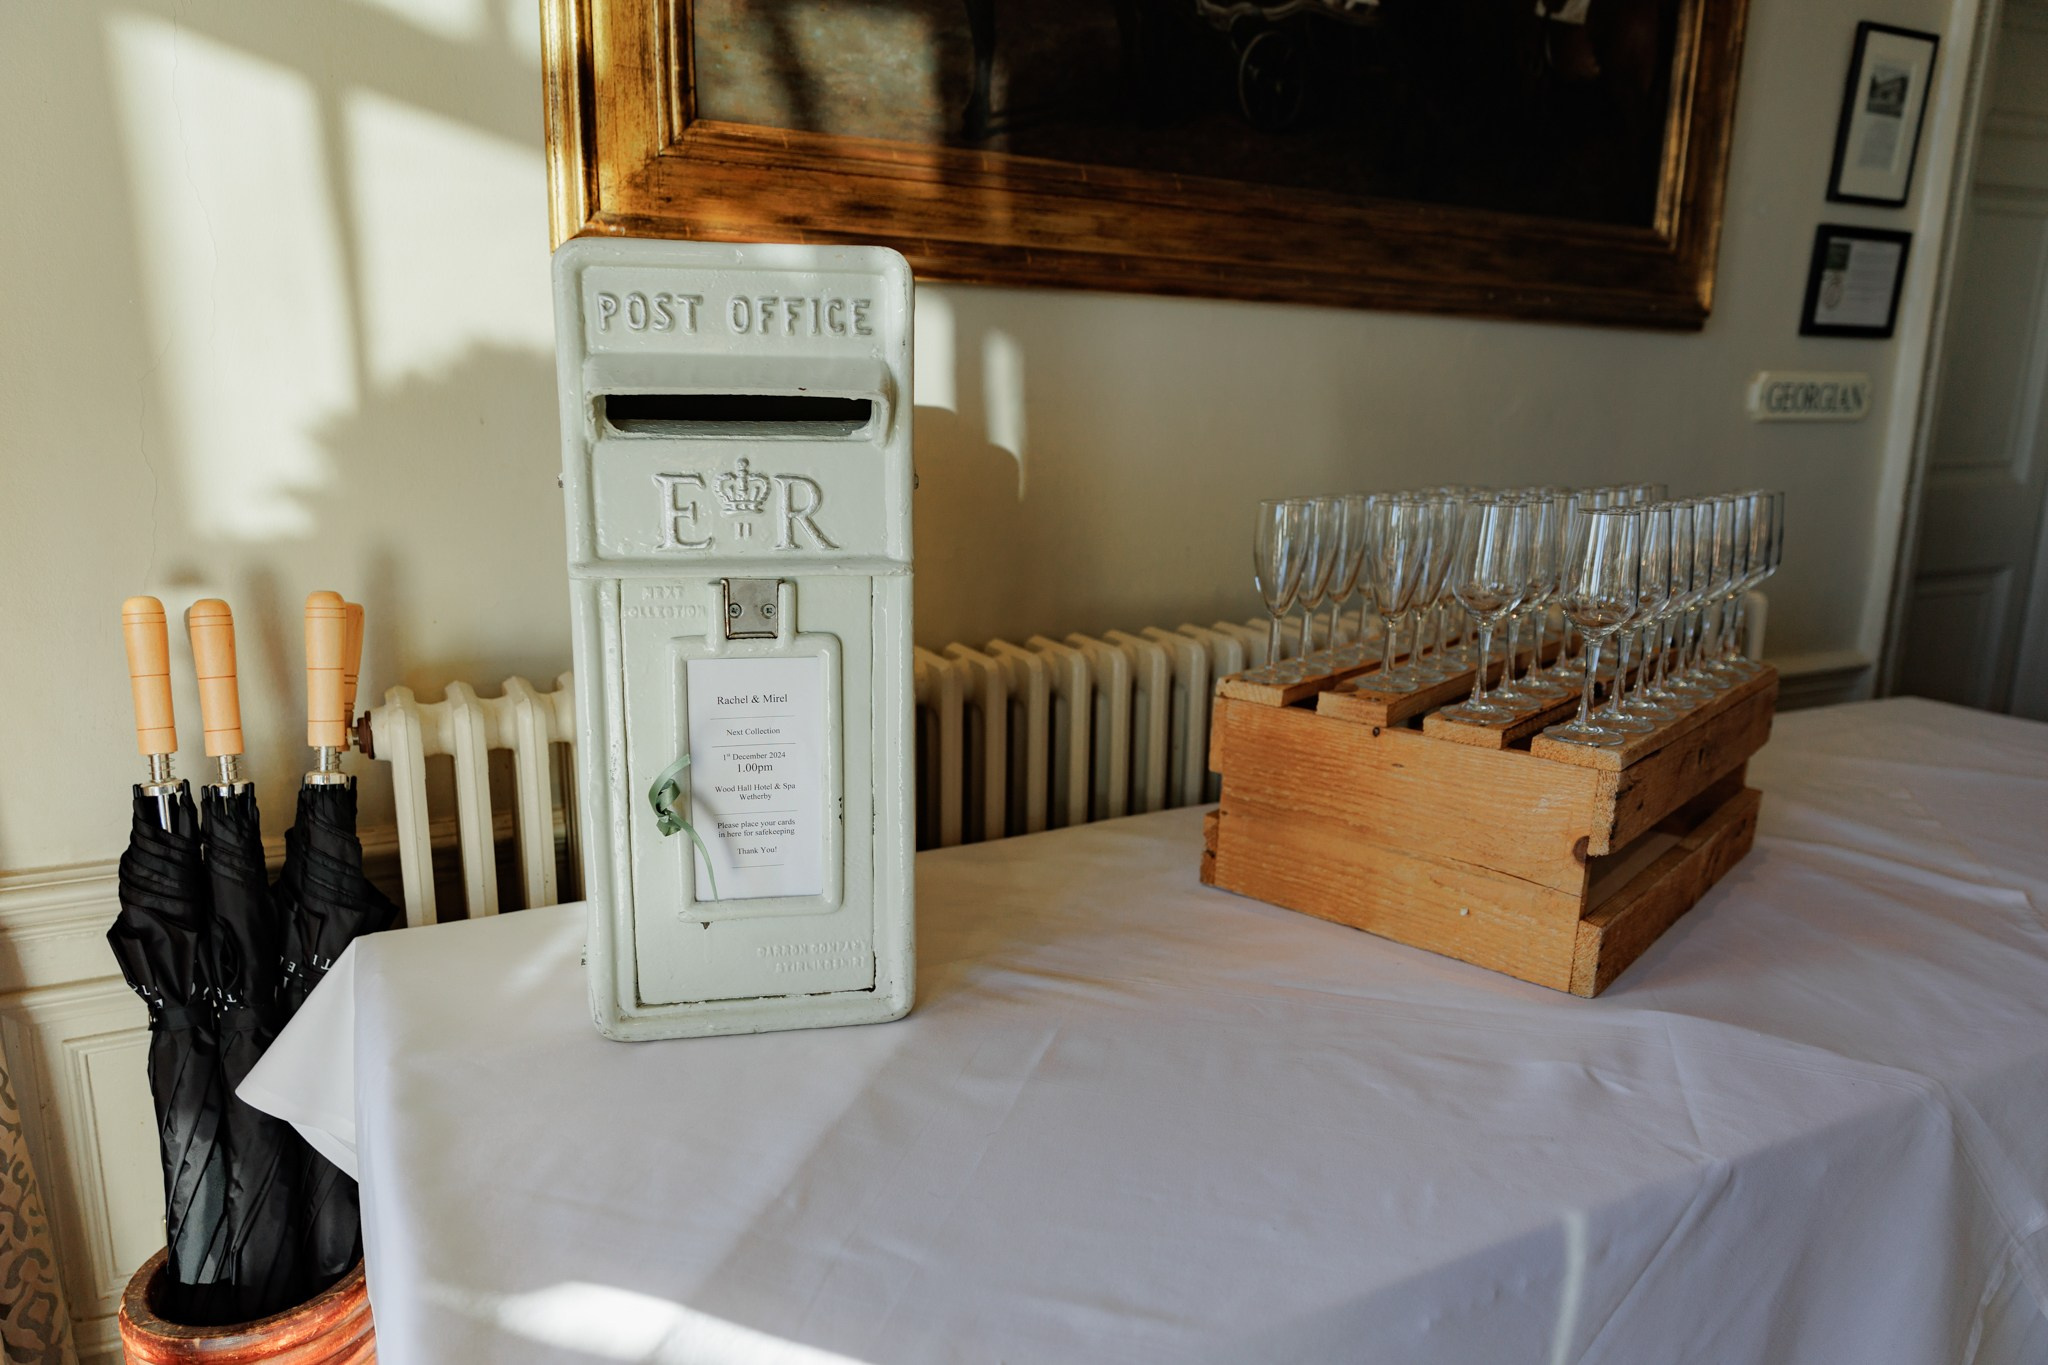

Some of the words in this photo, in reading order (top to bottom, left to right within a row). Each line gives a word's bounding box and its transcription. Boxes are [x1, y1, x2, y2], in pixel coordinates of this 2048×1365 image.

[597, 291, 703, 333] POST
[726, 294, 874, 336] OFFICE
[1766, 381, 1867, 413] GEORGIAN
[652, 471, 714, 551] E
[773, 472, 840, 551] R
[717, 695, 748, 705] Rachel
[751, 694, 760, 704] &
[763, 693, 788, 703] Mirel
[726, 728, 743, 736] Next
[744, 727, 781, 735] Collection
[723, 753, 731, 761] 1st
[732, 752, 767, 761] December
[769, 751, 786, 759] 2024
[737, 762, 773, 774] 1.00pm
[715, 784, 736, 793] Wood
[737, 784, 752, 792] Hall
[754, 783, 773, 791] Hotel
[783, 782, 796, 791] Spa
[739, 793, 772, 801] Wetherby
[717, 821, 739, 829] Please
[740, 820, 759, 829] place
[760, 819, 775, 828] your
[727, 830, 742, 838] here
[743, 829, 753, 837] for
[755, 828, 795, 836] safekeeping
[737, 847, 759, 855] Thank
[760, 846, 777, 854] You!
